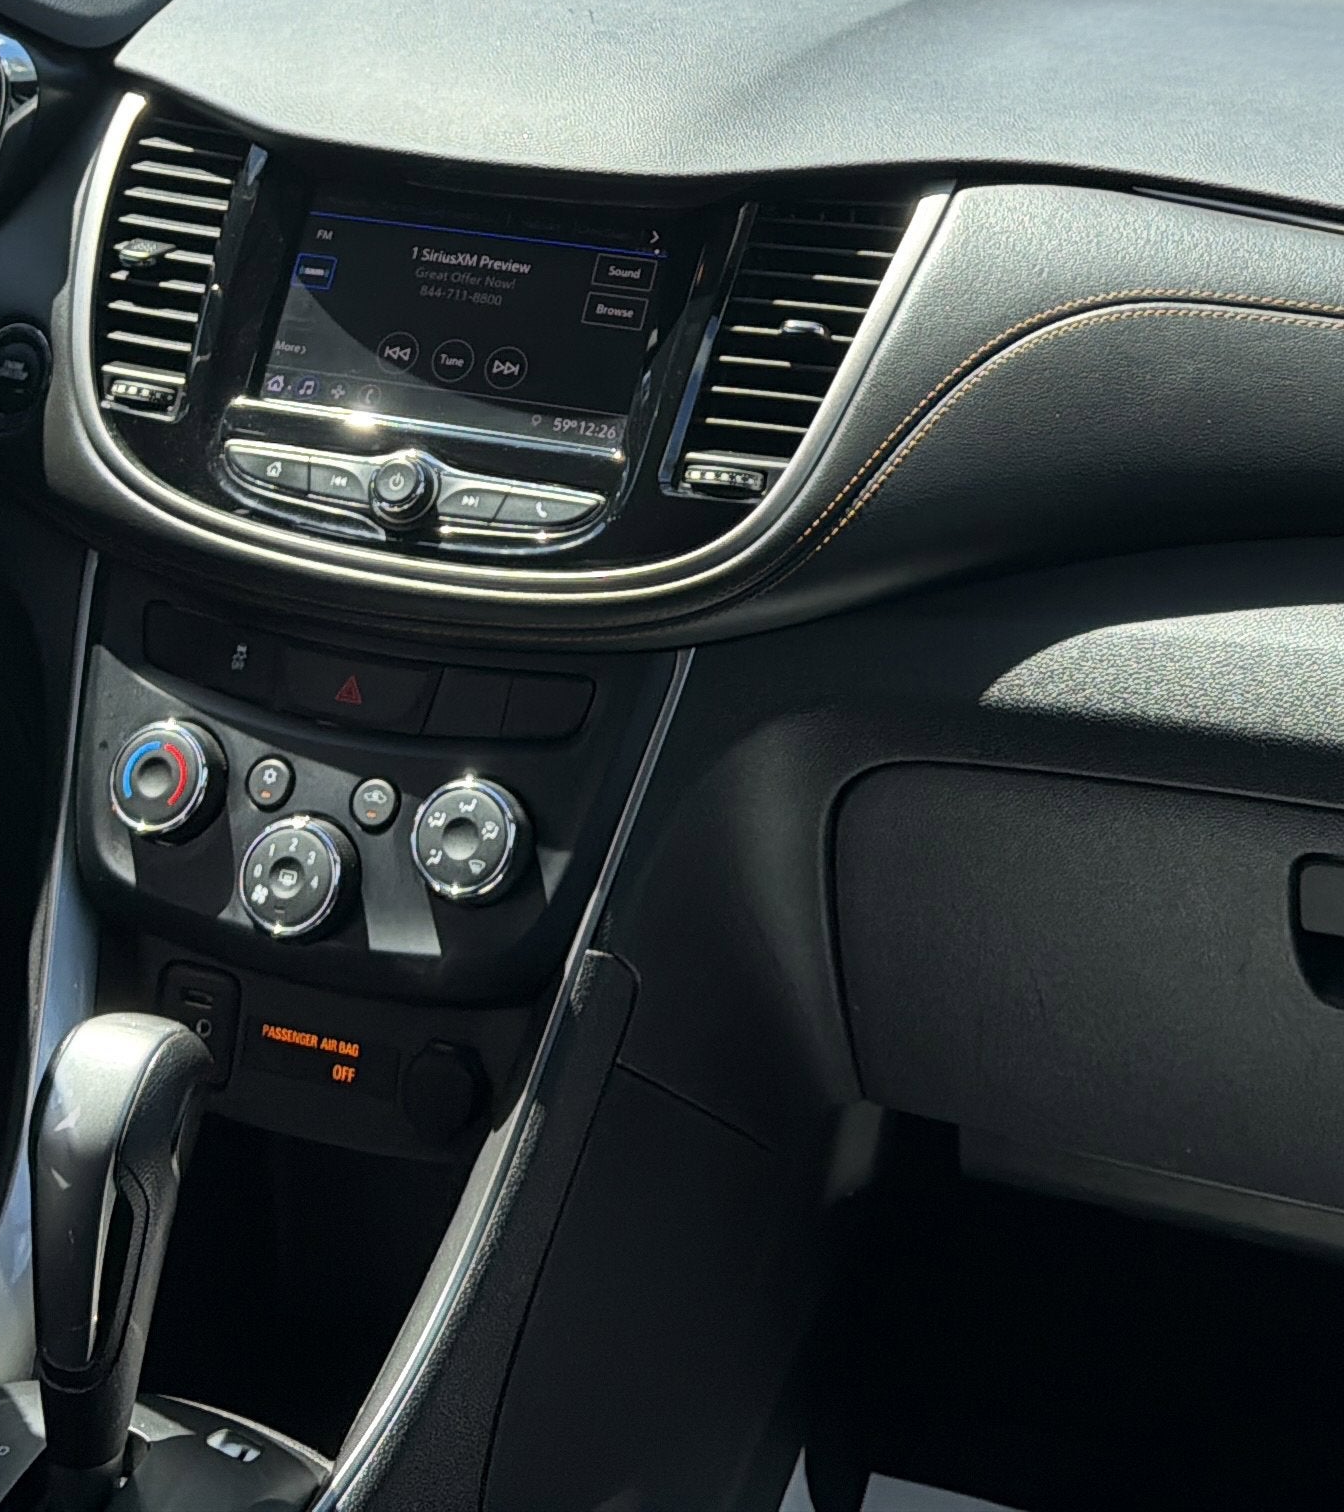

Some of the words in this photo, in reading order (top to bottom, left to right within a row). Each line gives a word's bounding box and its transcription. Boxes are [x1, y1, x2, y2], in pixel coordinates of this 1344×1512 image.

[316, 229, 333, 240] FM
[412, 246, 419, 260] 1
[421, 248, 477, 268] SiriusXM
[479, 254, 531, 274] Preview
[415, 266, 449, 283] Great
[451, 270, 481, 286] Offer
[484, 274, 516, 289] Now!
[608, 265, 641, 280] Sound
[419, 284, 503, 307] 844-711-8800
[595, 303, 634, 319] Browse
[440, 353, 465, 368] Tune
[578, 420, 617, 439] 12:26
[268, 843, 276, 857] 1
[288, 837, 299, 852] 2
[307, 850, 316, 865] 3
[253, 863, 263, 878] 0
[310, 875, 319, 889] 4
[262, 1023, 319, 1048] PASSENGER
[338, 1040, 360, 1057] BAG
[332, 1063, 356, 1083] OFF
